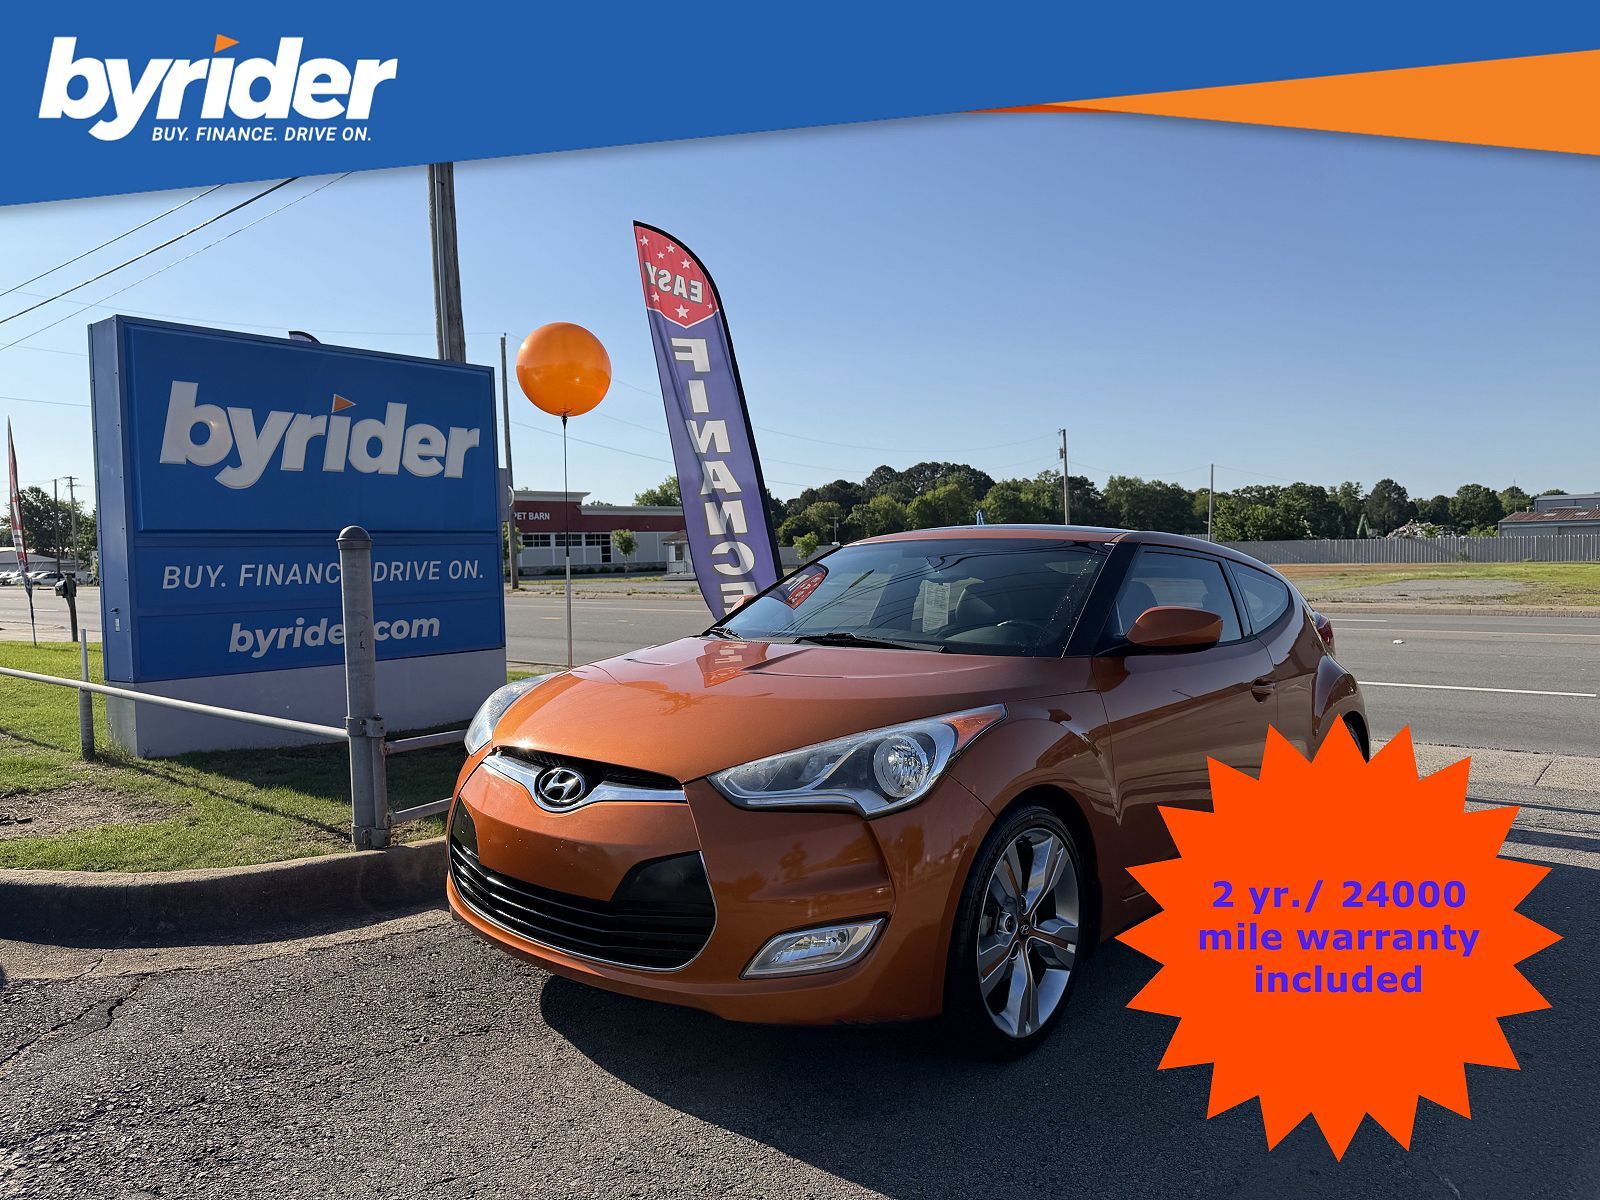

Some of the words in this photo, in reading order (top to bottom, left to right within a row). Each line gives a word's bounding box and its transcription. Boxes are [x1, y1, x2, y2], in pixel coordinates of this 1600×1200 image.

[159, 380, 481, 490] byrider
[528, 511, 550, 520] BARN
[162, 565, 227, 590] BUY.
[239, 562, 341, 587] FINANC
[373, 560, 442, 582] DRIVE
[448, 560, 484, 580] ON.
[228, 616, 440, 659] byridecom
